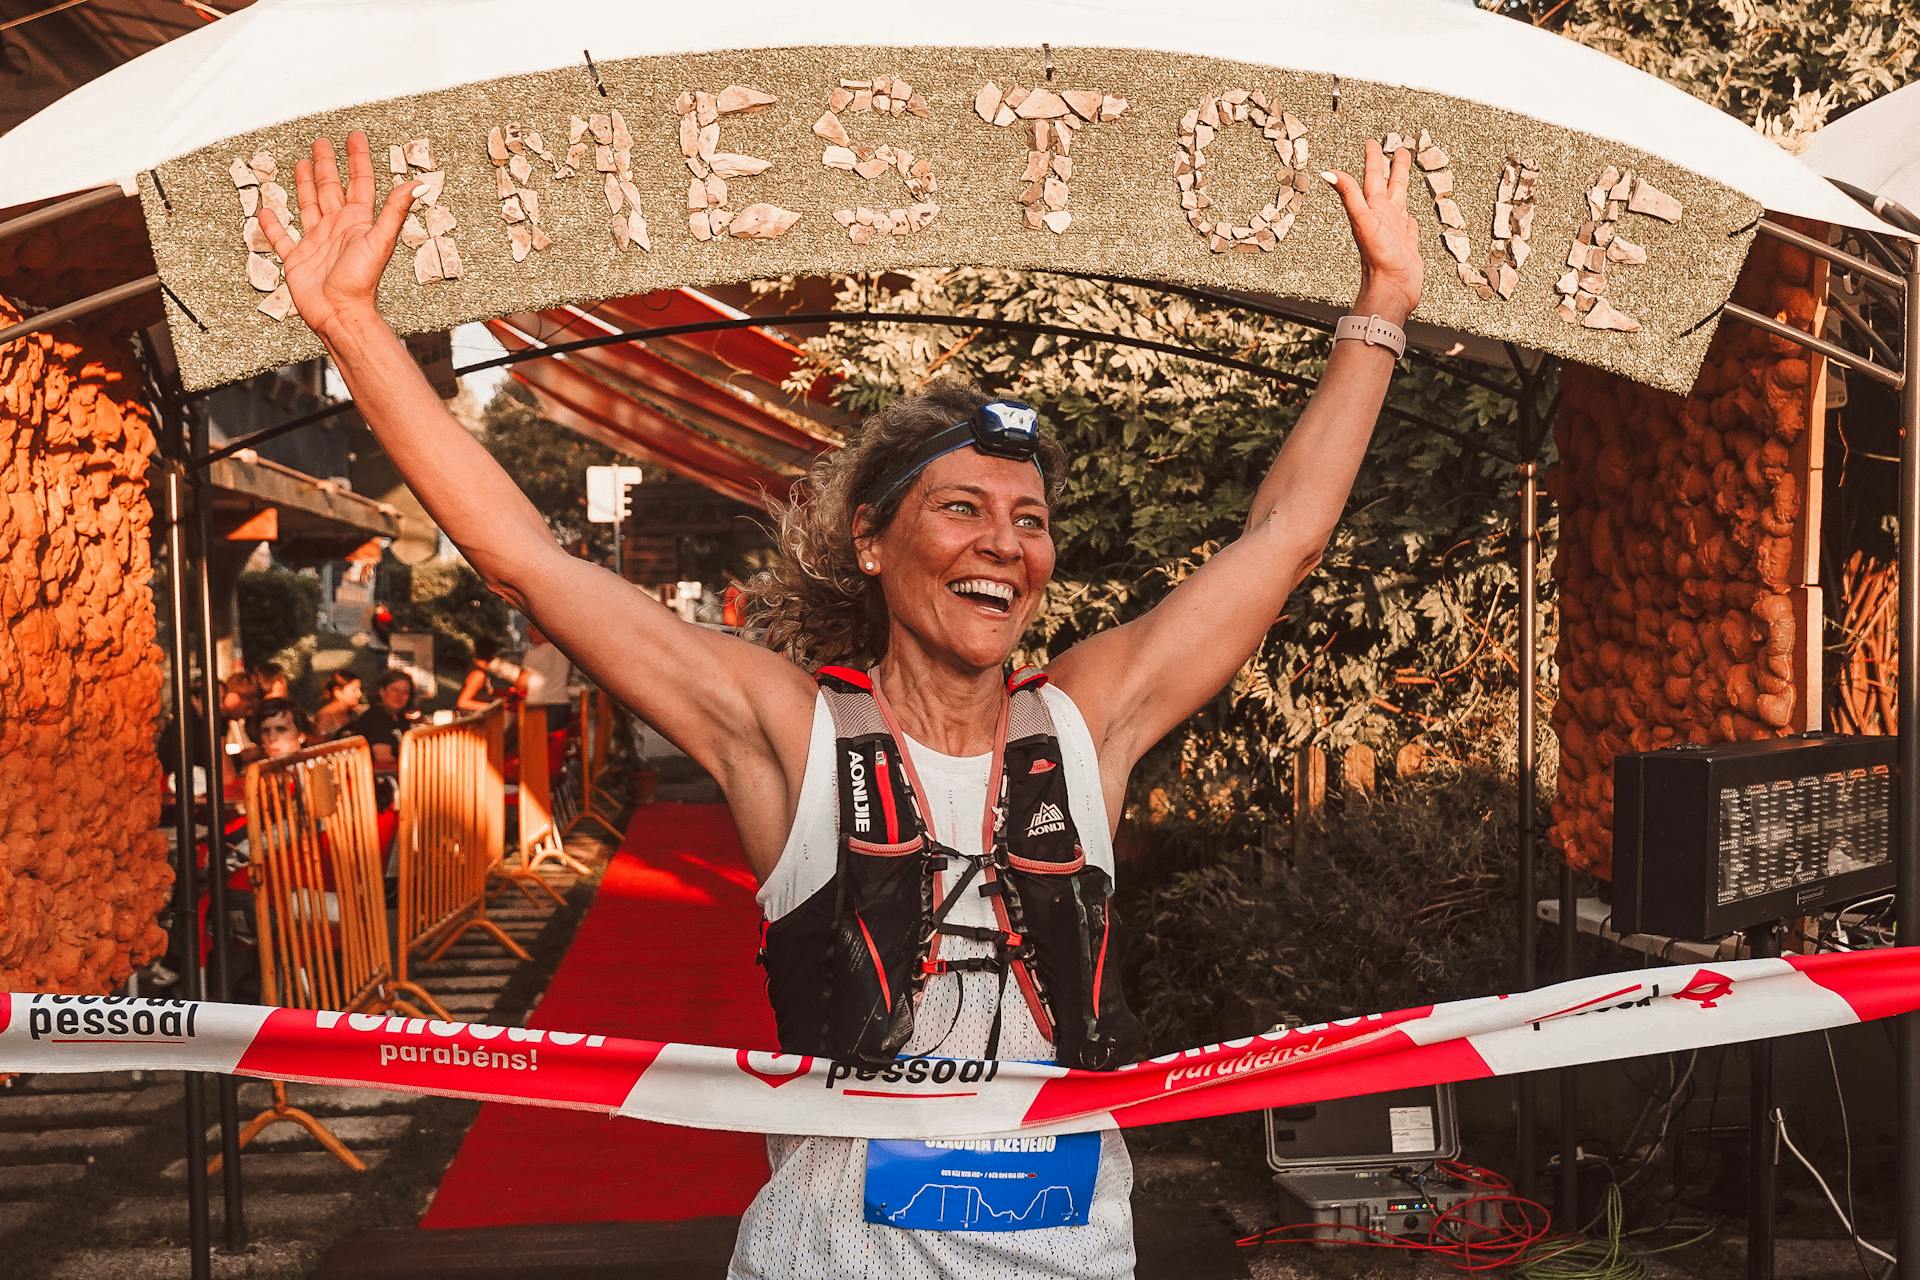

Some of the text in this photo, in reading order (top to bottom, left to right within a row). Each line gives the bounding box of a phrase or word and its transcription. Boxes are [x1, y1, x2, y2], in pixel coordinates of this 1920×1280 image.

[848, 750, 871, 833] AONIJIE
[29, 1003, 199, 1041] pessoal
[380, 1043, 539, 1072] parabéns!
[993, 1135, 1057, 1153] AZEVEDO
